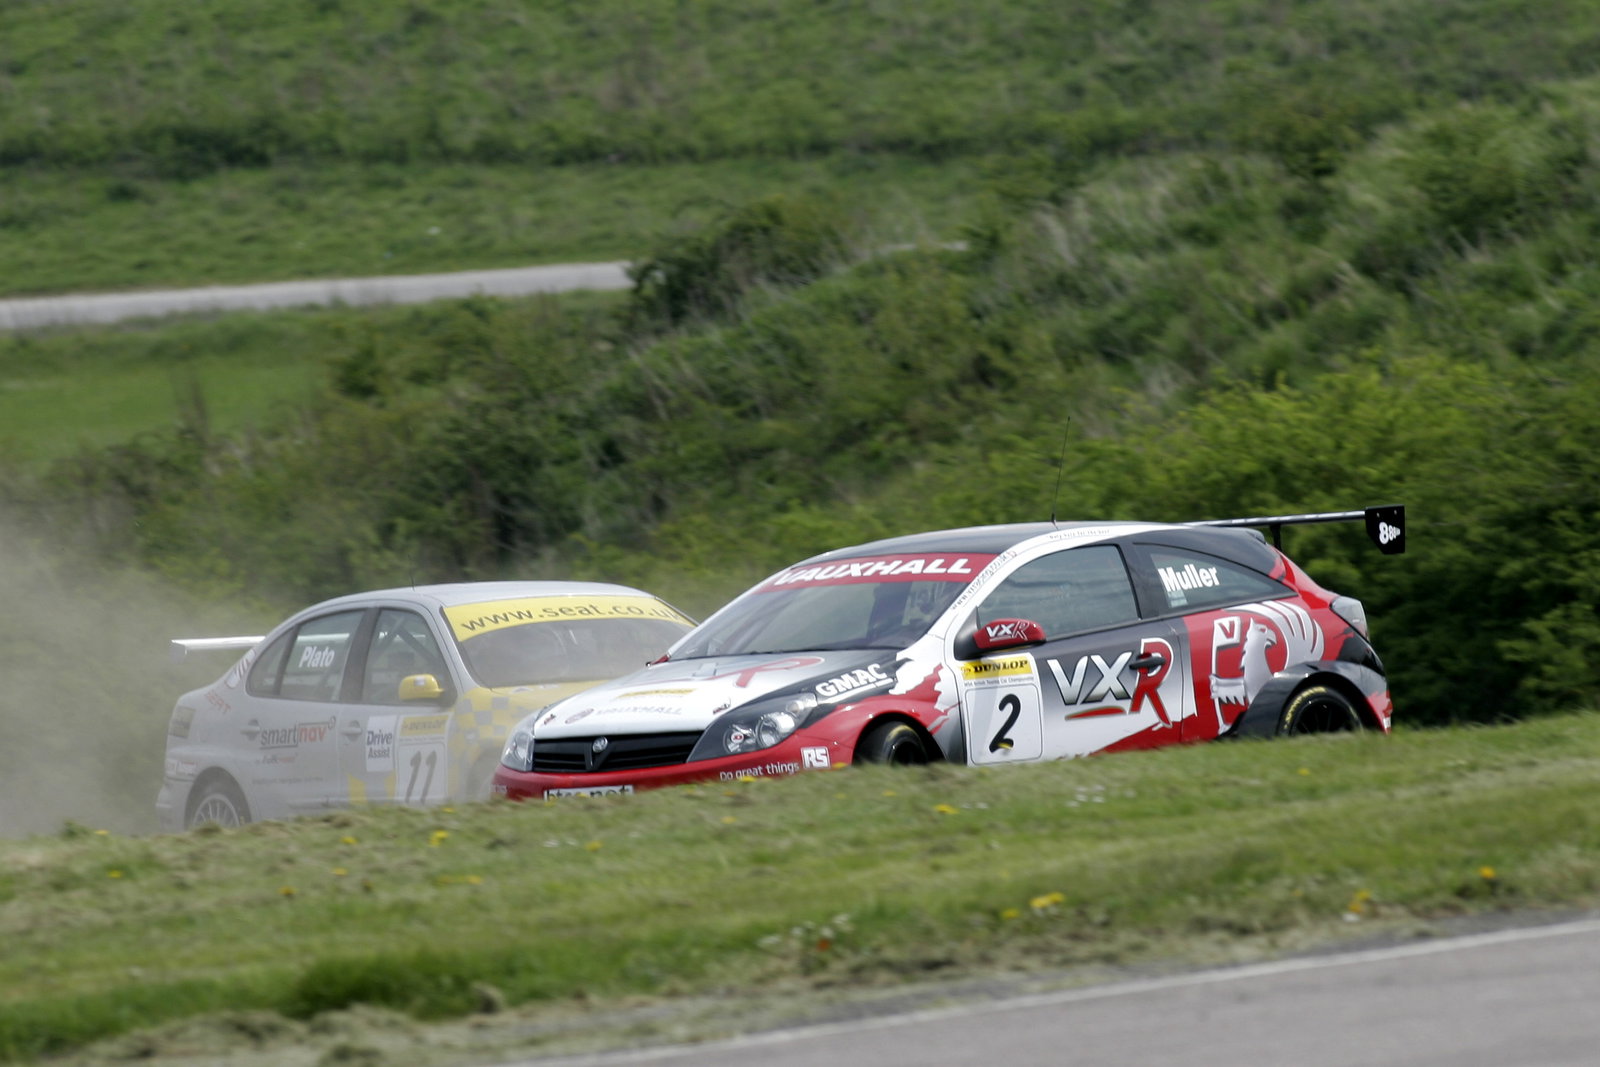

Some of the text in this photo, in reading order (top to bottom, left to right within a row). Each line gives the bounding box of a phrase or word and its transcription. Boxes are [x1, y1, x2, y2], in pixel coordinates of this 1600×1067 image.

[773, 557, 972, 586] VAUXHALL
[1158, 564, 1220, 593] Muller
[985, 620, 1029, 642] VXR
[299, 646, 335, 668] Plato
[973, 660, 1028, 673] DUNLOP
[815, 663, 888, 697] GMAC
[1046, 638, 1173, 728] VXR
[260, 722, 327, 746] smartnav
[989, 694, 1021, 753] 2
[366, 729, 393, 746] Drive
[367, 747, 391, 760] Assist
[803, 749, 830, 768] RS
[404, 750, 437, 805] 11
[720, 762, 800, 781] Do great things
